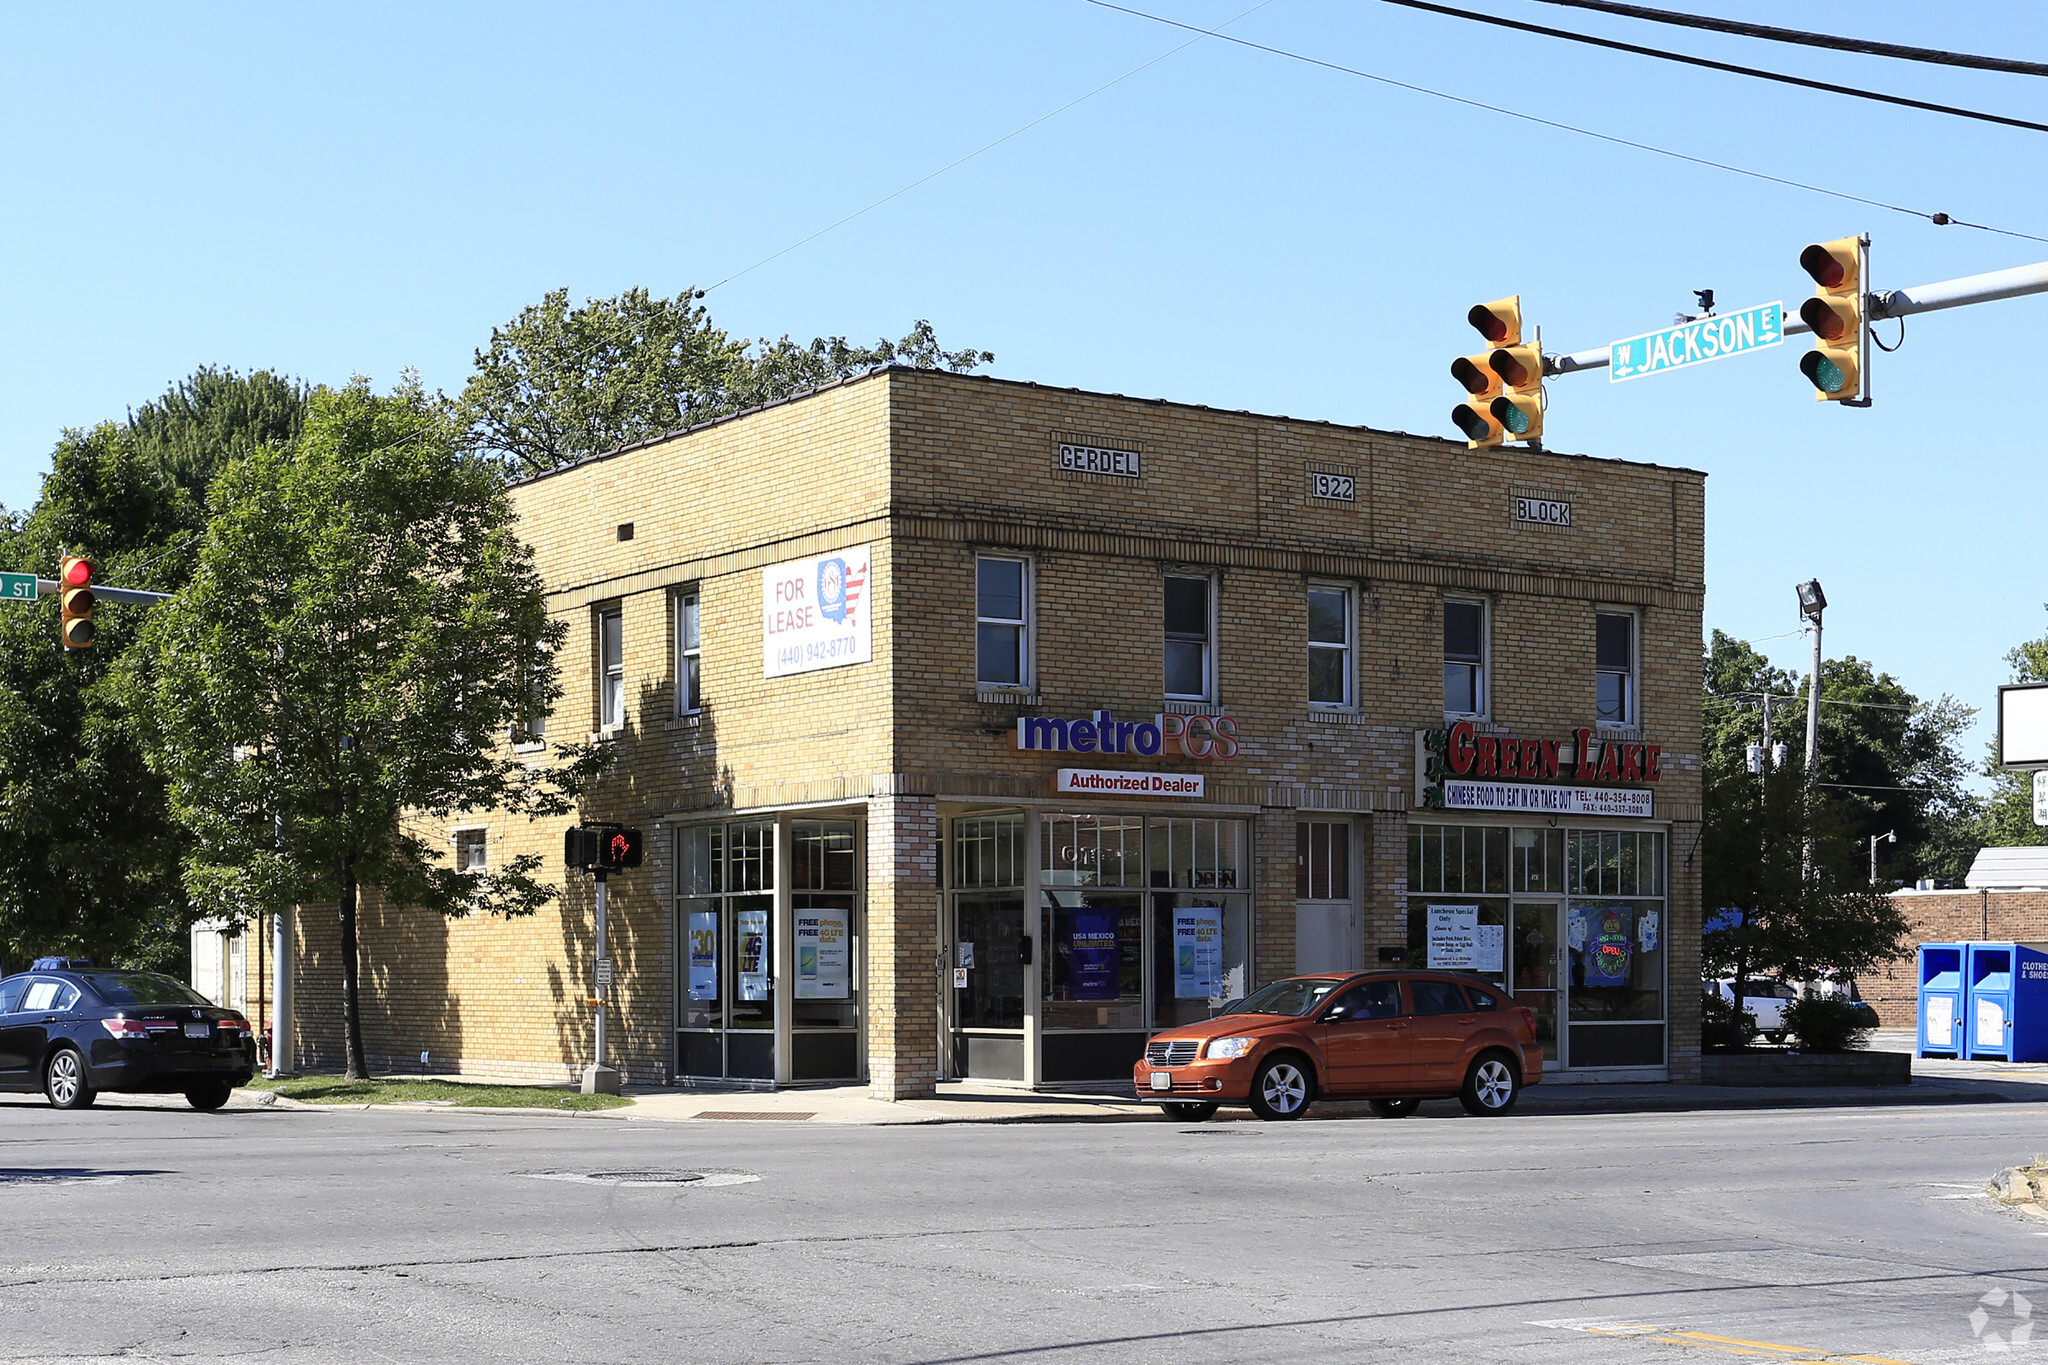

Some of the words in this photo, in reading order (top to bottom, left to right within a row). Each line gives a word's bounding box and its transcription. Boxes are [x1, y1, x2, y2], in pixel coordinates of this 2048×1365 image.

[1617, 344, 1632, 366] W
[1637, 312, 1755, 373] JACKSON
[1761, 308, 1774, 331] E
[1061, 446, 1138, 476] GERDEL
[1313, 475, 1353, 499] 1922
[1517, 500, 1569, 524] BLOCK
[13, 582, 32, 597] ST
[776, 578, 804, 604] FOR
[768, 606, 814, 634] LEASE
[777, 644, 804, 671] (440)
[806, 635, 856, 661] 942-8770
[1018, 710, 1240, 760] metroPCS
[1449, 721, 1562, 779] GREEN
[1573, 728, 1662, 782] LAKE
[1069, 773, 1149, 791] Authorized
[1152, 776, 1199, 792] Dealer
[1447, 785, 1474, 805] CHINESE
[1476, 786, 1494, 806] FOOD
[1496, 786, 1505, 806] TO
[1507, 787, 1519, 807] EAT
[1521, 788, 1528, 807] IN
[1529, 788, 1539, 808] OR
[1541, 788, 1557, 809] TAKE
[1559, 790, 1572, 809] OUT
[1575, 790, 1592, 802] TEL:
[1594, 791, 1650, 804] 440-354-8008
[1583, 803, 1597, 812] FAX:
[691, 930, 714, 954] $30
[744, 936, 762, 955] 4G
[1087, 932, 1115, 940] MEXICO
[741, 956, 760, 973] LTE
[2022, 971, 2026, 979] &
